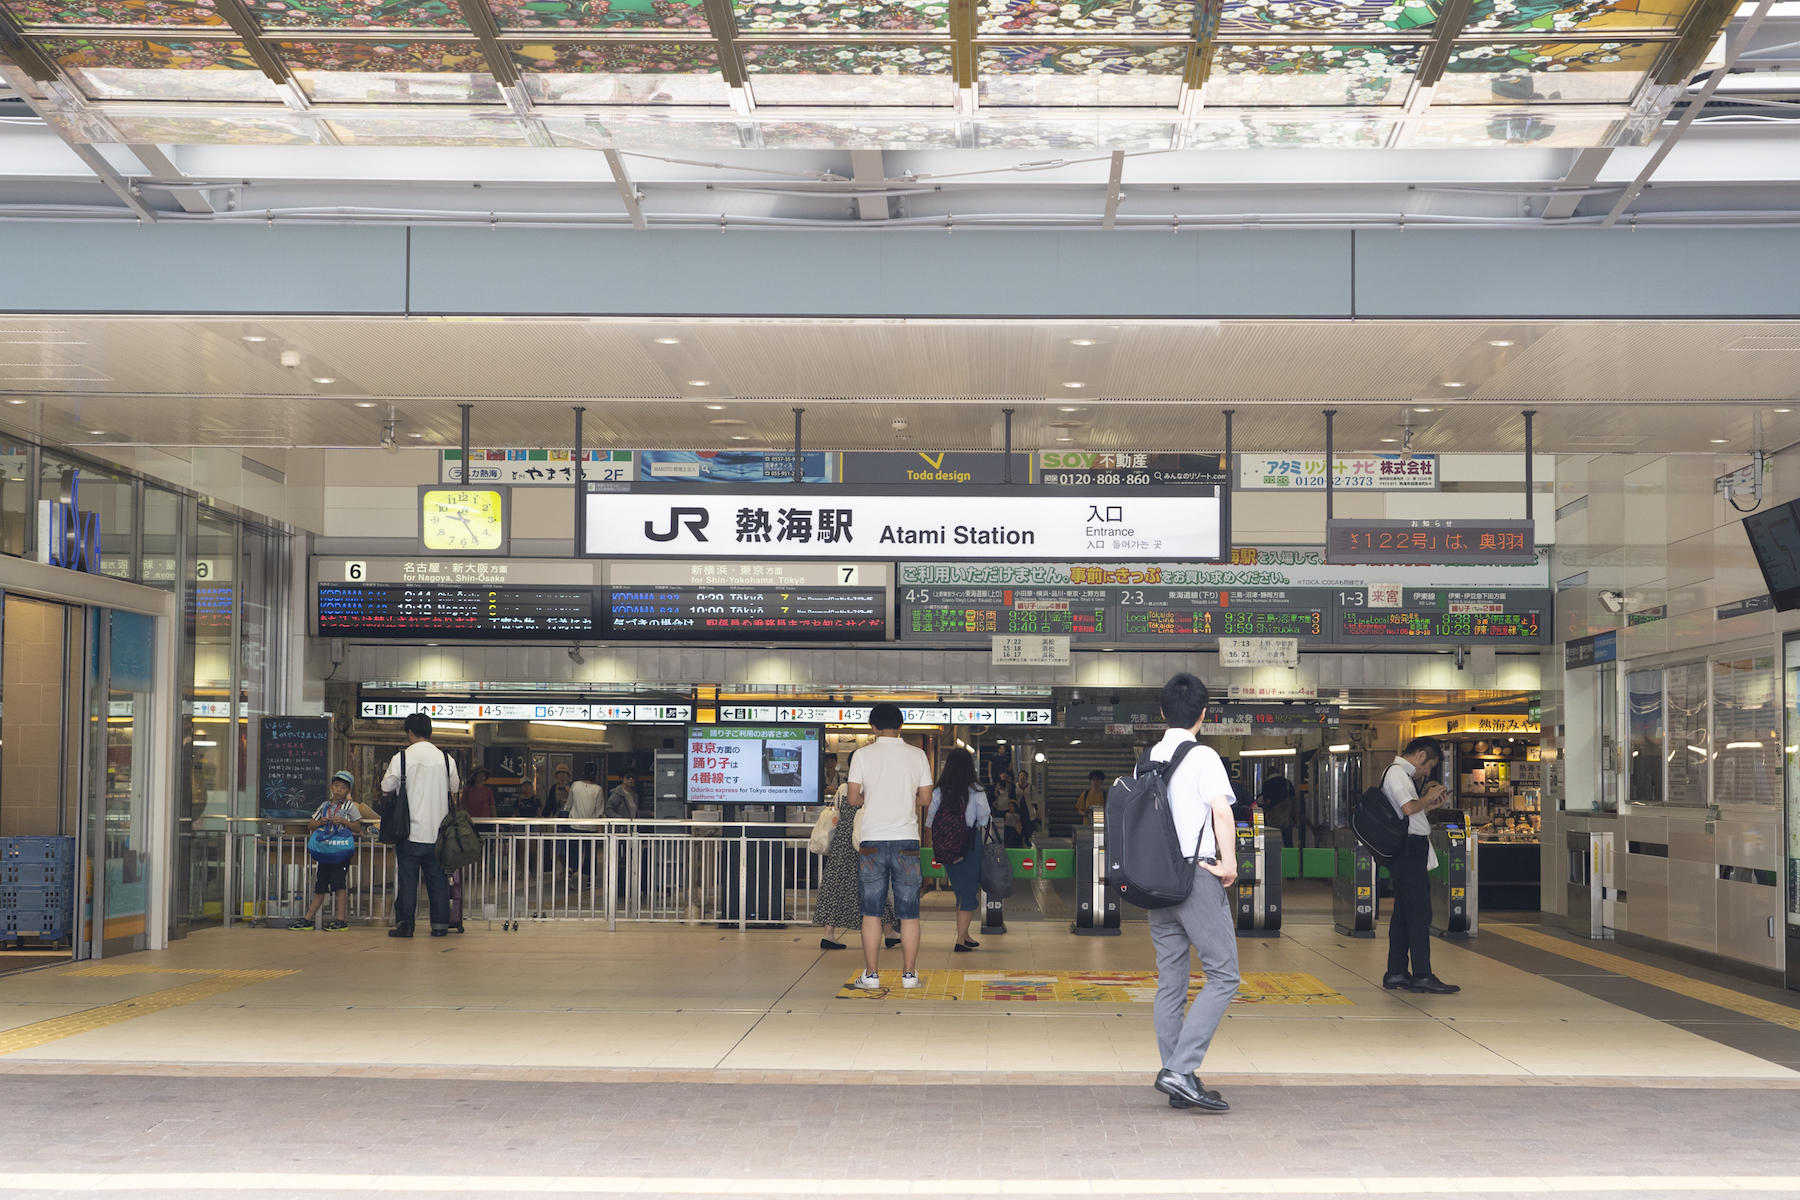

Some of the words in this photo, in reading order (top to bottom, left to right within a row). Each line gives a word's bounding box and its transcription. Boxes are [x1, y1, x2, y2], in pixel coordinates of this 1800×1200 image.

[1099, 453, 1148, 469] 不動産
[1266, 460, 1301, 475] アタミ
[1352, 460, 1376, 475] ナビ
[1380, 460, 1432, 475] 株式会社
[604, 469, 624, 481] 2F
[907, 470, 934, 481] Toda
[935, 470, 971, 483] design
[1087, 505, 1123, 523] 入口
[645, 507, 710, 542] JR
[736, 507, 853, 544] 熱海駅
[879, 525, 945, 544] Atami
[954, 525, 1035, 545] Station
[1086, 527, 1135, 537] Entrance
[1086, 540, 1105, 549] 入口
[350, 564, 362, 579] 6
[842, 568, 854, 583] 7
[418, 574, 453, 582] Nagoya,
[1009, 610, 1037, 622] 9:26
[1095, 611, 1104, 622] 5
[1224, 612, 1253, 623] 9:37
[1312, 612, 1320, 623] 3
[1442, 613, 1471, 625] 9:38
[1009, 621, 1037, 633] 9:40
[1095, 621, 1104, 632] 4
[1224, 623, 1253, 634] 9:59
[1256, 623, 1300, 633] Shizuoka
[1312, 623, 1320, 634] 3
[1435, 624, 1471, 635] 10:23
[1529, 624, 1538, 636] 2
[691, 742, 740, 754] 東京方面の
[693, 757, 738, 769] 踊り子は
[691, 772, 740, 784] 4番線です
[749, 787, 766, 795] Tokyo
